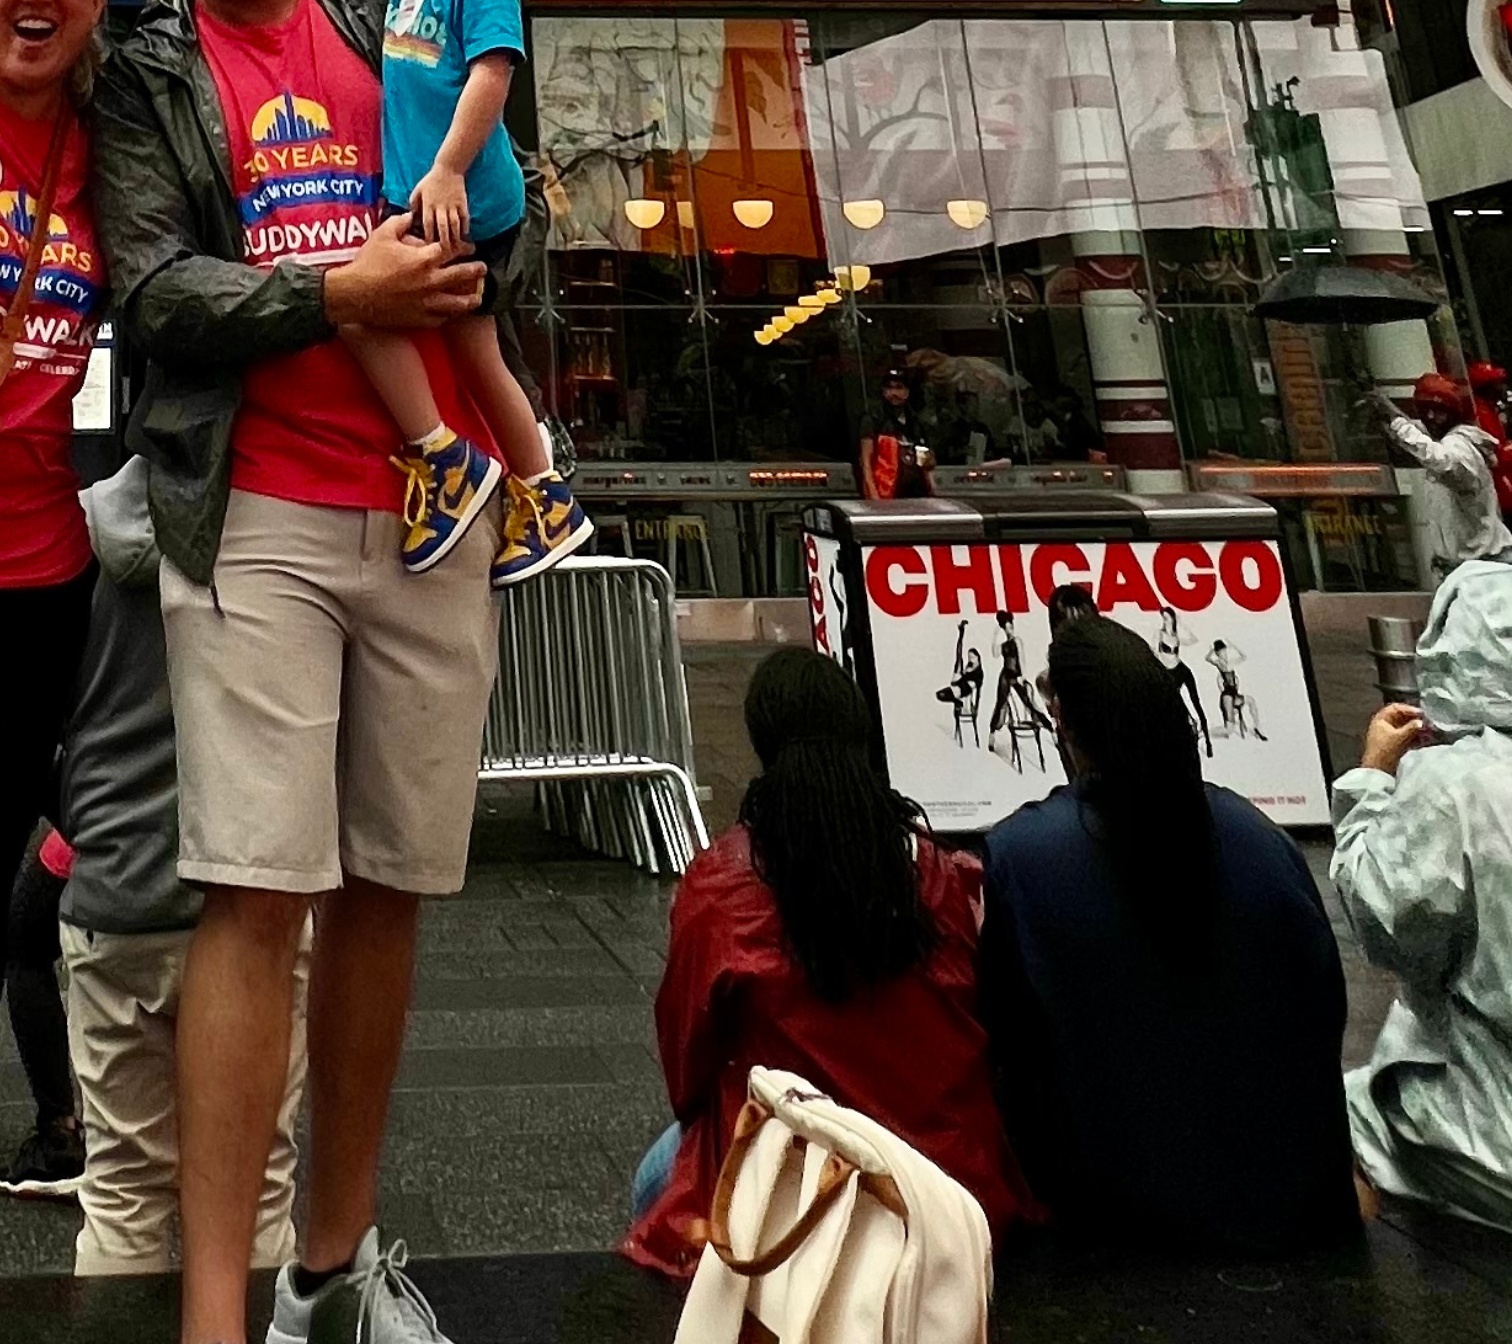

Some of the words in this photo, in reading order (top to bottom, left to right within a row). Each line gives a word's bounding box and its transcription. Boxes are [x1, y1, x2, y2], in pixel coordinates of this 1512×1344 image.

[271, 143, 359, 170] YEARS
[281, 179, 329, 197] YORK
[330, 179, 364, 196] CITY
[55, 279, 89, 303] CITY
[865, 539, 1284, 618] CHICAGO
